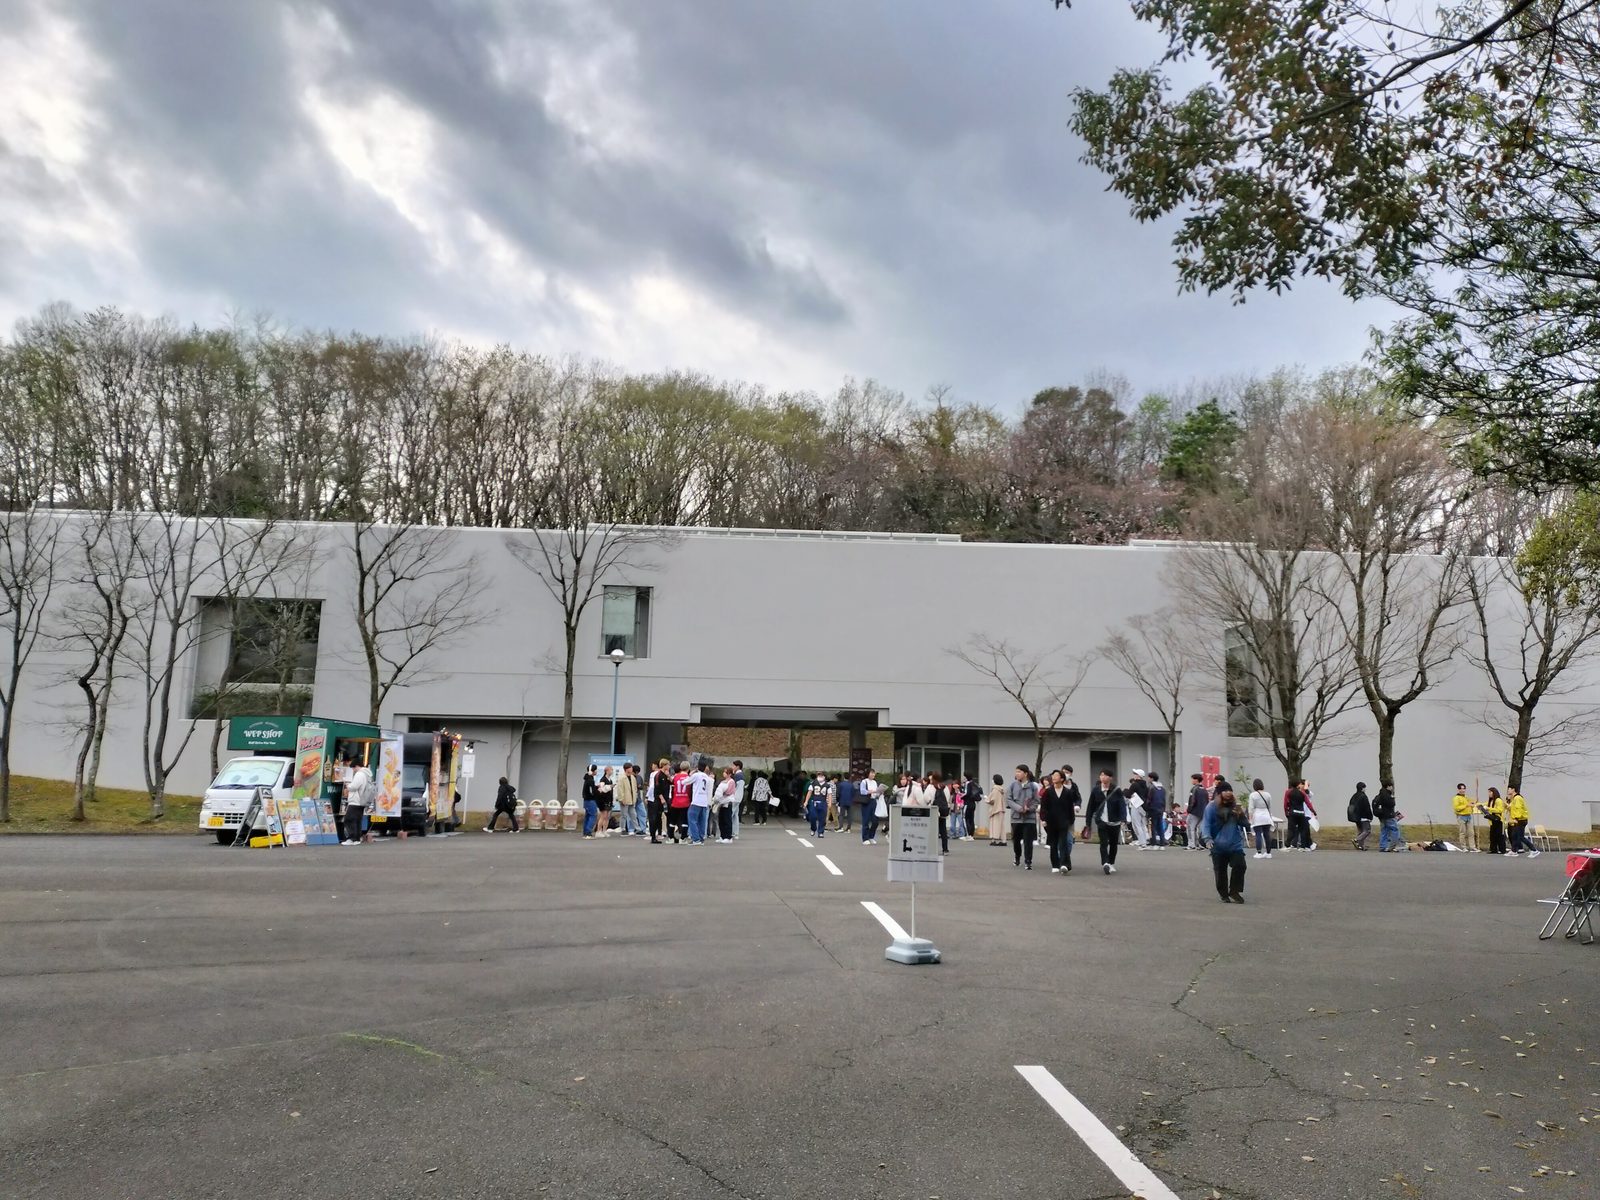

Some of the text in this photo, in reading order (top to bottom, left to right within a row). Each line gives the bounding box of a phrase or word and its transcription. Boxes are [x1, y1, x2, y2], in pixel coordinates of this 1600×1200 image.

[262, 729, 283, 739] SHOP
[677, 780, 687, 793] 17
[814, 785, 827, 796] 24
